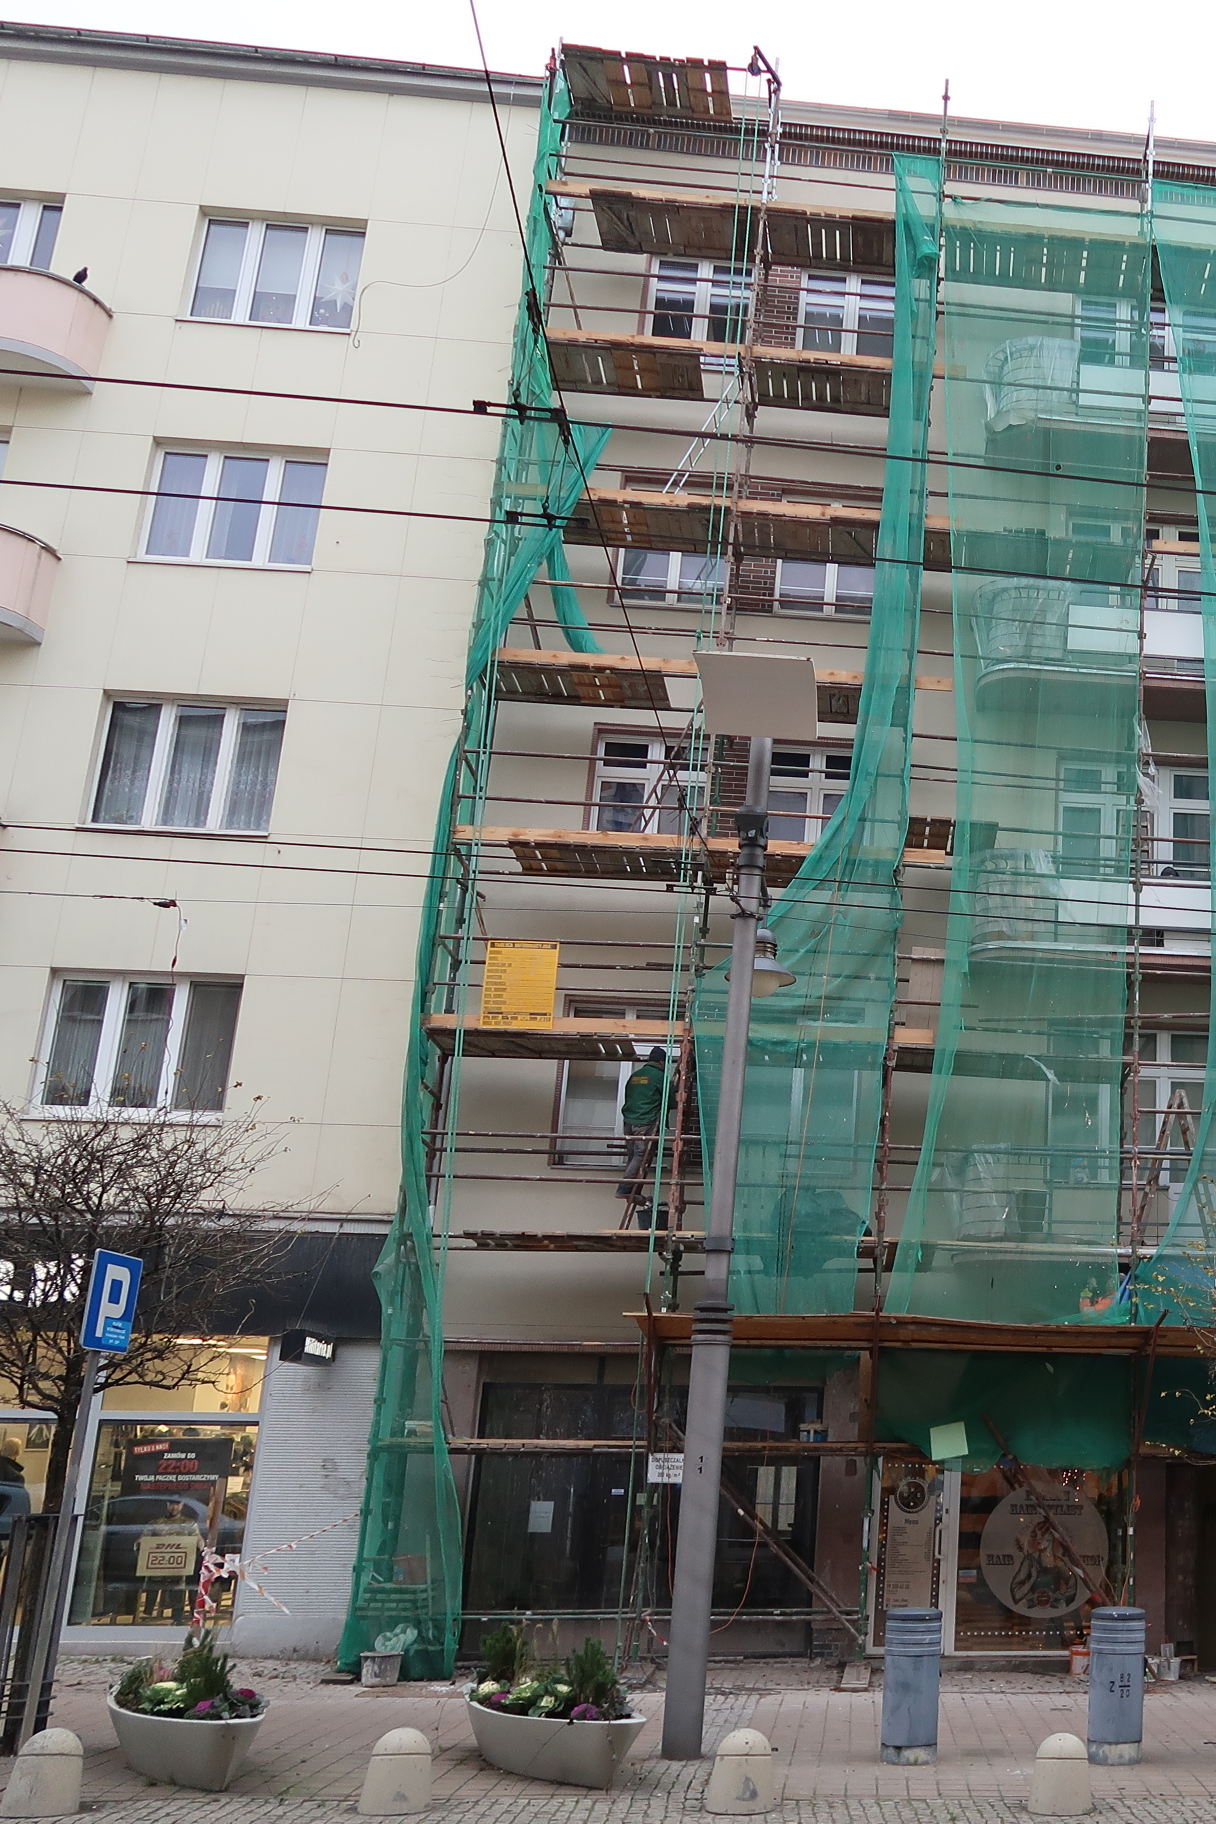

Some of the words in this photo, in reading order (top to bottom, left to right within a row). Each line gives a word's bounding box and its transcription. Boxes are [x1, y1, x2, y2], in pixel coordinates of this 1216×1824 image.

[95, 1263, 131, 1338] P
[158, 1459, 198, 1472] 22:00
[150, 1555, 183, 1566] 22:00
[1109, 1680, 1115, 1693] Z
